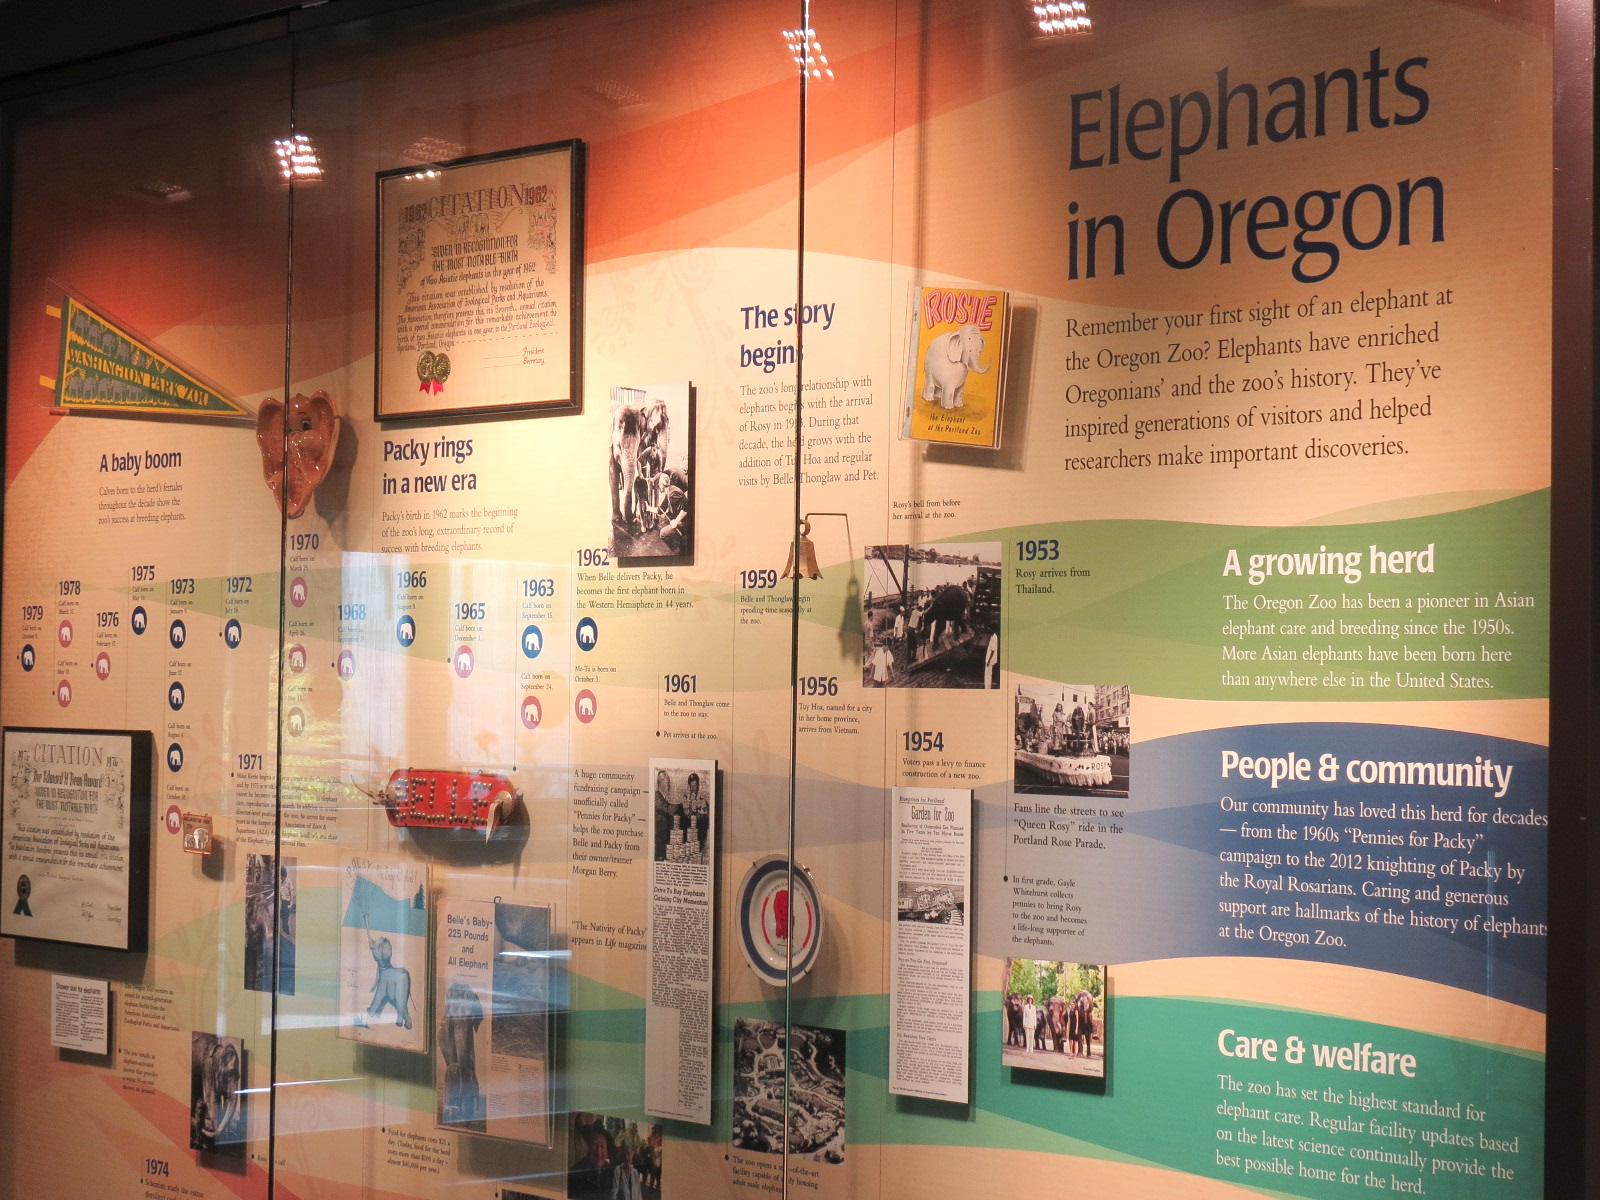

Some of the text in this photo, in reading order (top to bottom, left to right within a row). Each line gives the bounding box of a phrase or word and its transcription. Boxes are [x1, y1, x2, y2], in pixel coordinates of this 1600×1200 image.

[1068, 46, 1430, 184] Elephants
[427, 182, 548, 219] CITATION 1962
[1067, 175, 1446, 284] in Oregon
[740, 302, 836, 331] The story
[924, 288, 997, 331] ROSIE
[1065, 287, 1454, 339] Remember your first sight of an elephant at
[1065, 321, 1440, 372] the Oregon Zoo? Elephants have enriched
[740, 339, 804, 374] begin
[67, 348, 210, 406] WASHINGTON PARK ZOO
[1065, 359, 1442, 408] Oregonians' and the zoo's history. They've
[940, 414, 966, 423] Elephant
[1064, 395, 1433, 442] inspired generations of visitors and helped
[935, 424, 944, 432] the
[945, 425, 969, 435] Portland
[970, 428, 981, 436] Zoo
[383, 436, 474, 466] Packy rings
[1064, 434, 1409, 472] researchers make important discoveries.
[100, 450, 182, 477] A baby boom
[382, 472, 477, 494] in a new era
[290, 533, 319, 550] 1970
[1016, 539, 1060, 561] 1953
[576, 548, 610, 567] 1962
[1222, 543, 1435, 586] A growing herd
[131, 565, 155, 581] 1975
[397, 570, 427, 589] 1966
[576, 571, 674, 583] When Belle delivers Packy, he
[740, 569, 778, 589] 1959
[1016, 566, 1090, 580] Rosy arrives from
[59, 580, 81, 596] 1978
[170, 578, 195, 594] 1973
[226, 576, 253, 593] 1972
[522, 579, 555, 597] 1963
[576, 585, 685, 596] becomes the first elephant born in
[1016, 584, 1055, 594] Thailand.
[337, 603, 367, 621] 1968
[454, 602, 485, 620] 1965
[576, 599, 694, 610] the Western Hemisphere in 44 years.
[1222, 591, 1535, 614] The Oregon Zoo has been a pioneer in Asian
[22, 605, 43, 621] 1979
[96, 611, 119, 627] 1976
[663, 674, 697, 693] 1961
[799, 676, 838, 697] 1956
[902, 731, 944, 752] 1954
[33, 743, 103, 767] CITATION
[238, 753, 263, 771] 1971
[902, 758, 921, 768] Voters
[922, 760, 935, 769] pass
[941, 760, 954, 770] levy
[964, 760, 986, 769] finance
[902, 770, 938, 779] construction
[939, 770, 947, 779] of
[953, 772, 967, 780] new
[1221, 750, 1513, 798] People & community
[911, 805, 955, 822] Garden for Zoo
[1014, 803, 1125, 818] Fans line the streets to see
[1220, 796, 1548, 826] Our community has loved this herd for decades
[1013, 818, 1123, 834] "Queen Rosy" ride in the
[1013, 834, 1106, 850] Portland Rose Parade.
[472, 916, 493, 928] Baby-
[448, 928, 489, 942] 225 Pounds
[461, 945, 474, 954] and
[448, 957, 488, 970] All Elephant
[1218, 1028, 1417, 1078] Care & welfare
[145, 1158, 170, 1177] 1974
